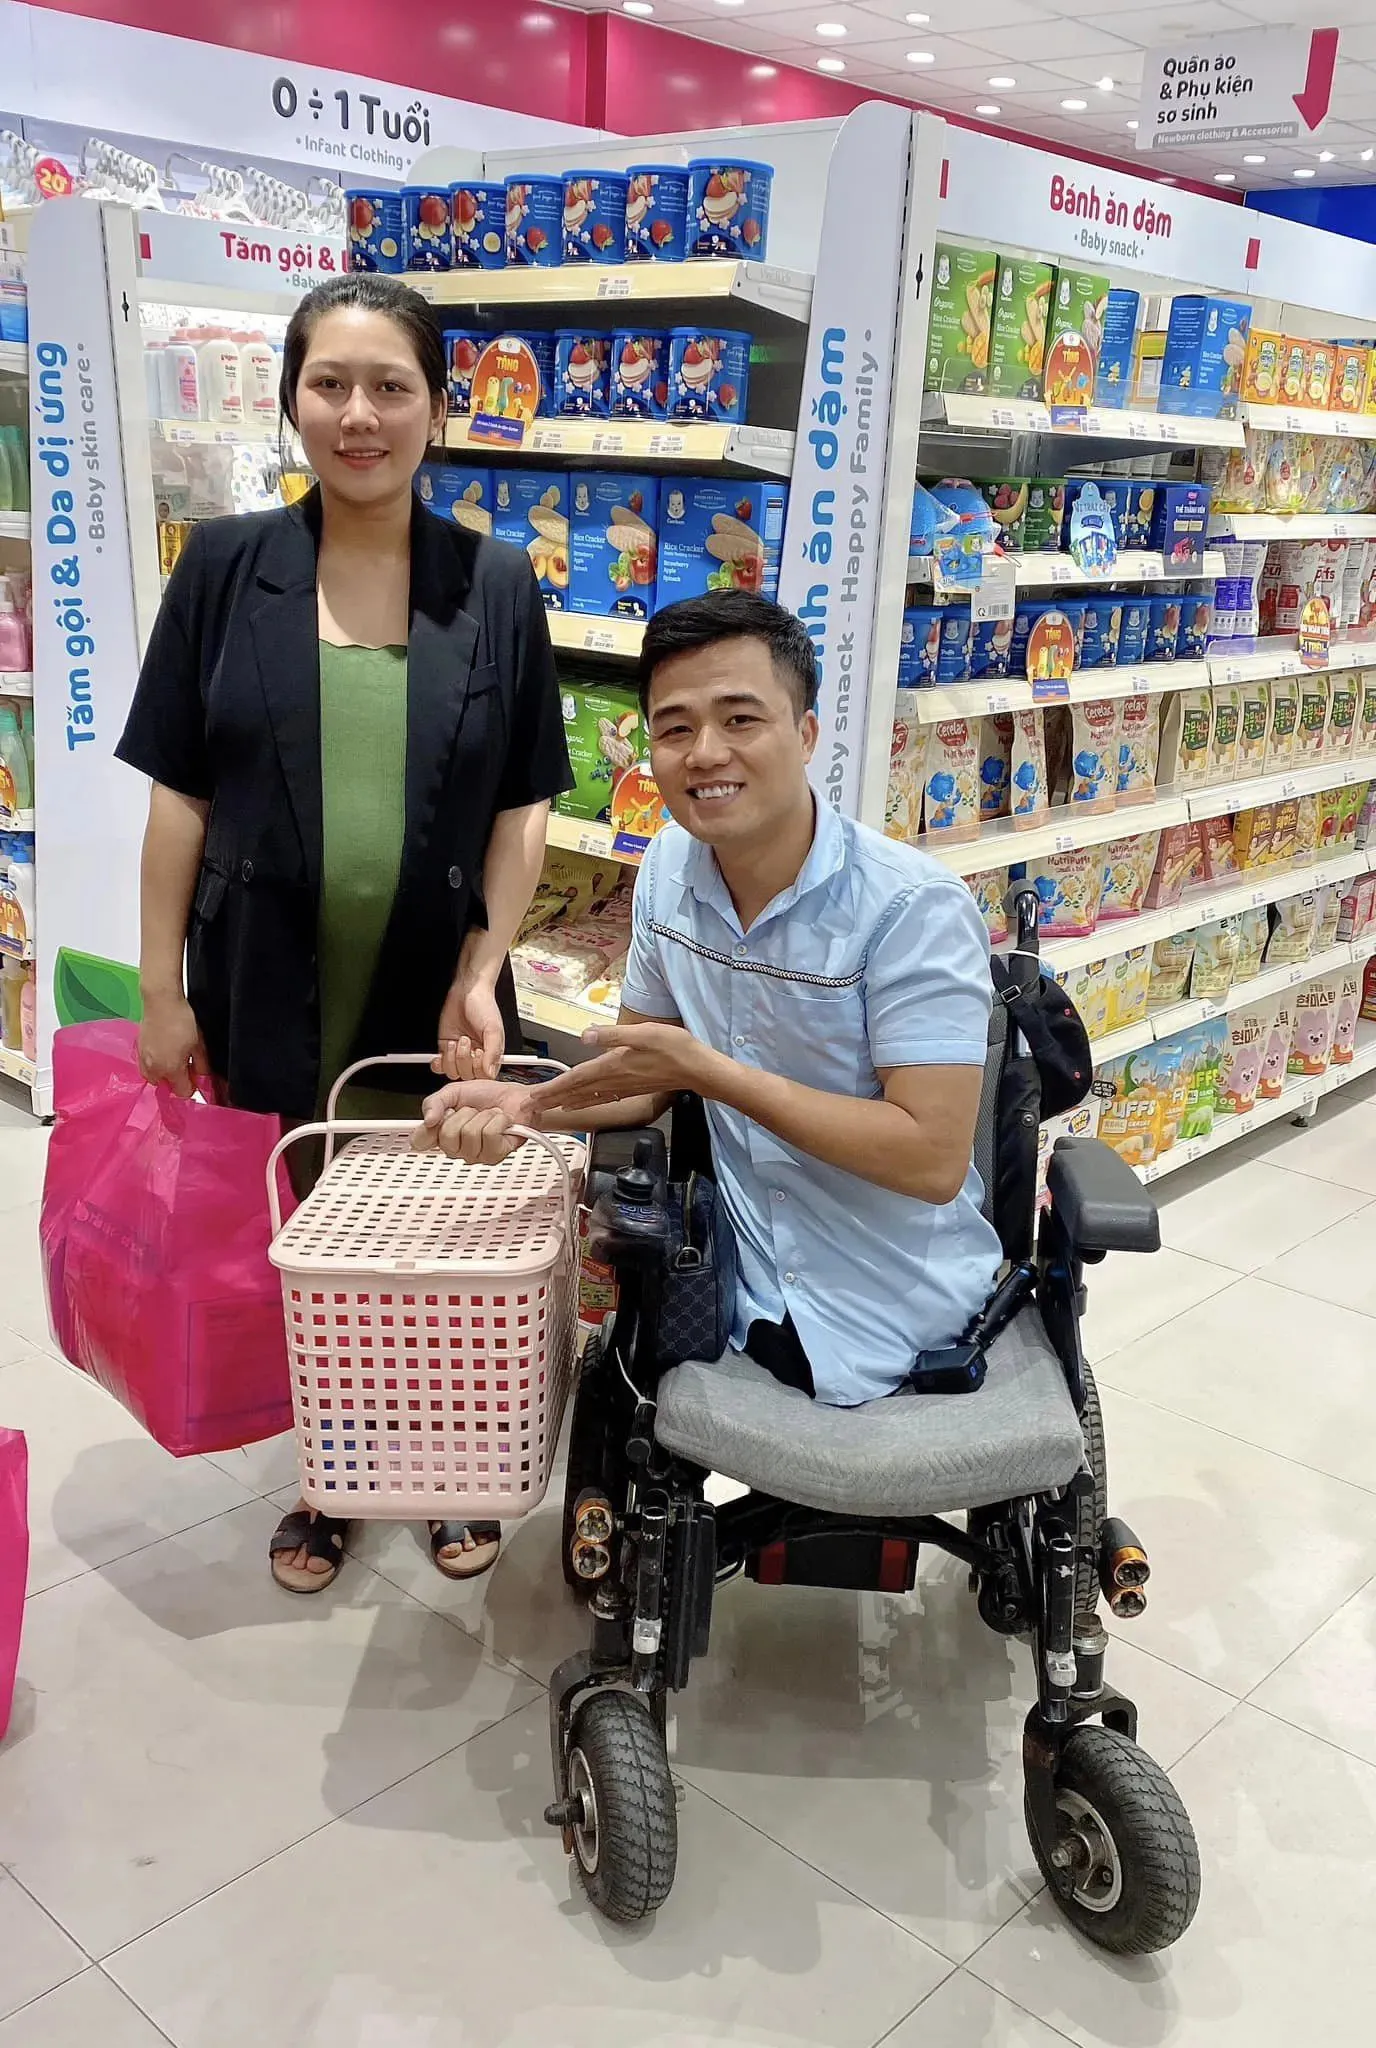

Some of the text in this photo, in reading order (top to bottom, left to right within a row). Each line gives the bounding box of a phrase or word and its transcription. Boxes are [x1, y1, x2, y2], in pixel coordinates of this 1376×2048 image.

[1159, 75, 1253, 101] & Phụ kiện
[272, 76, 298, 118] 0
[334, 89, 349, 130] 1
[359, 94, 430, 146] Tuổi
[1181, 101, 1217, 122] sinh
[305, 135, 403, 171] Infant Clothing
[1157, 124, 1294, 145] Newborn clothing & Accessories
[1050, 174, 1172, 241] Bánh ăn dặm
[220, 231, 271, 263] Tắm
[278, 243, 312, 272] gội
[319, 246, 336, 272] &
[1080, 228, 1139, 259] Baby snack
[809, 326, 848, 470] dặm
[850, 350, 879, 474] Family
[77, 357, 106, 540] Baby skin care
[574, 533, 605, 544] Rice Cracker
[801, 489, 835, 565] ăn
[840, 484, 872, 602] Happy
[35, 341, 96, 752] Tắm gội & Da dị ứng
[664, 542, 705, 553] Rice Cracker
[833, 631, 855, 732] snack
[938, 723, 966, 737] Cerelac
[1086, 705, 1114, 719] Cerelac
[1101, 1099, 1156, 1118] PUFFS
